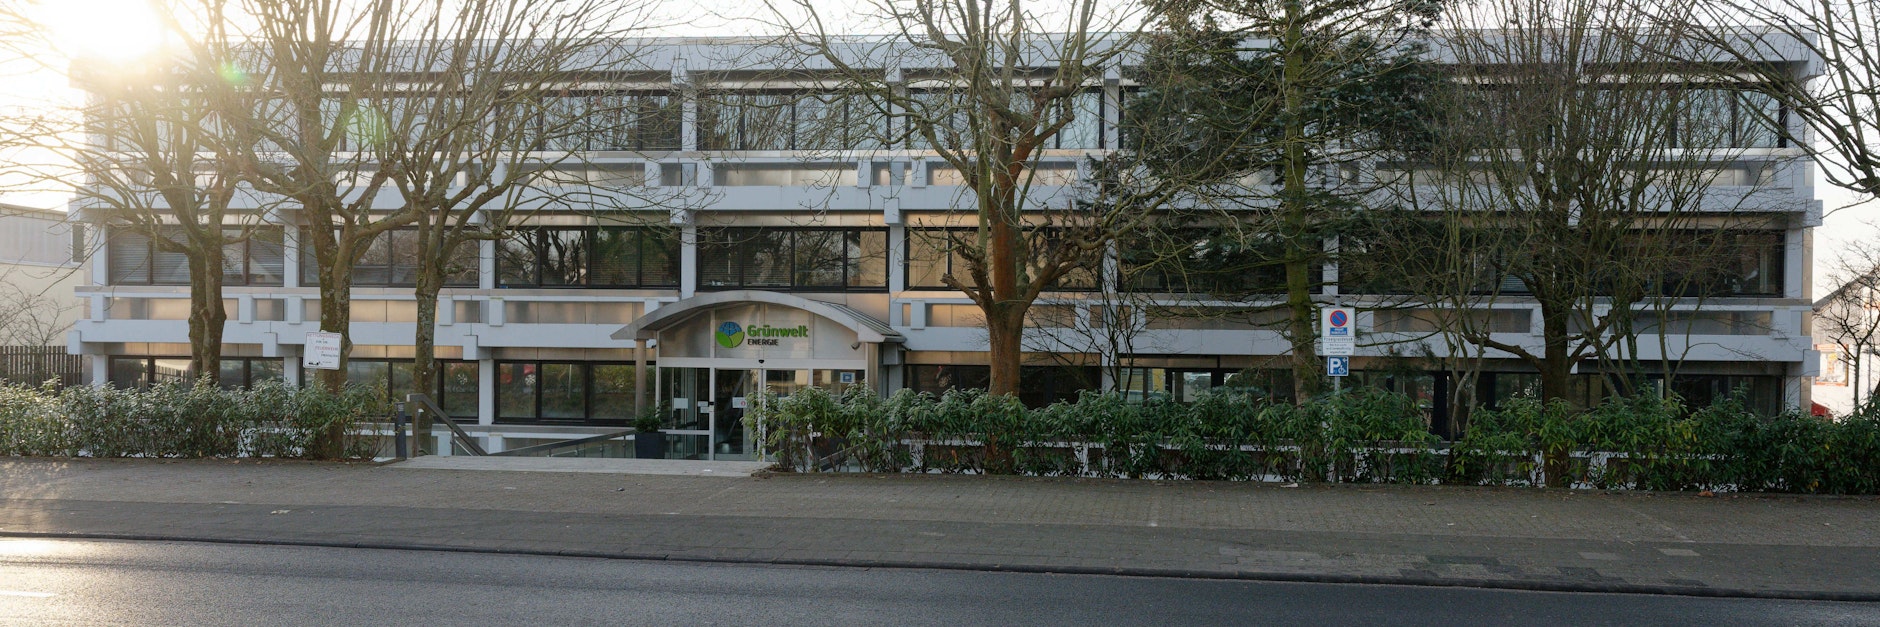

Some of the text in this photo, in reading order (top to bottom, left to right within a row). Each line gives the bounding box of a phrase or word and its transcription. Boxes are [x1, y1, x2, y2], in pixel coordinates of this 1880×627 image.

[747, 324, 809, 337] Grünwelt
[747, 338, 779, 346] ENERGIE
[1330, 358, 1341, 374] P
